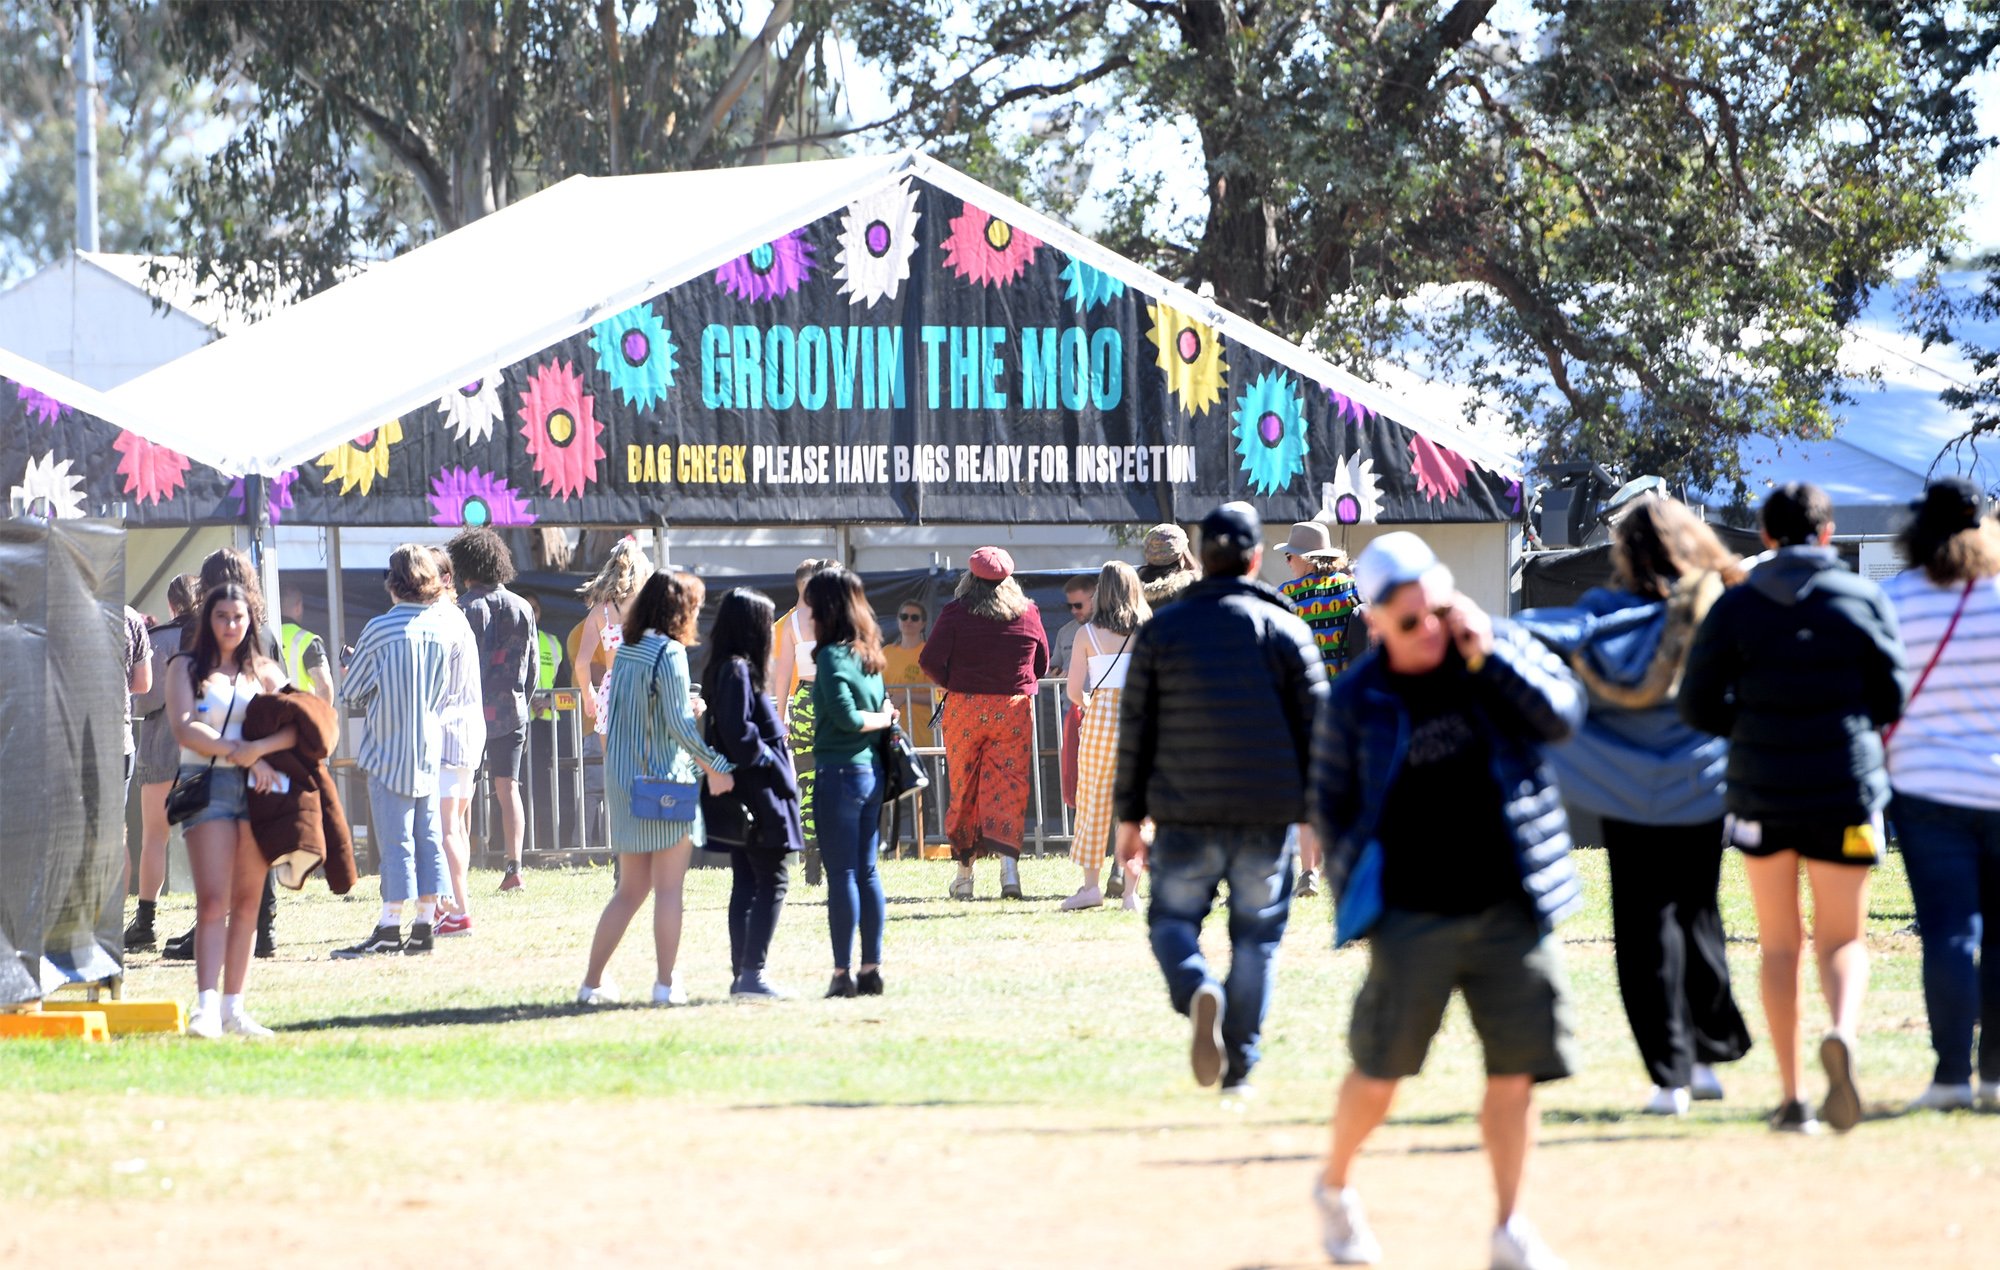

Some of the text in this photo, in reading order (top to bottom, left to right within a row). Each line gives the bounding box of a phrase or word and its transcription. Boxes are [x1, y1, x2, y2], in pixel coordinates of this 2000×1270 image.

[701, 324, 1122, 411] GROOVIN THE MOO
[627, 444, 1197, 484] BAG CHECK PLEASE HAVE BAGS READY FOR INSPECTION
